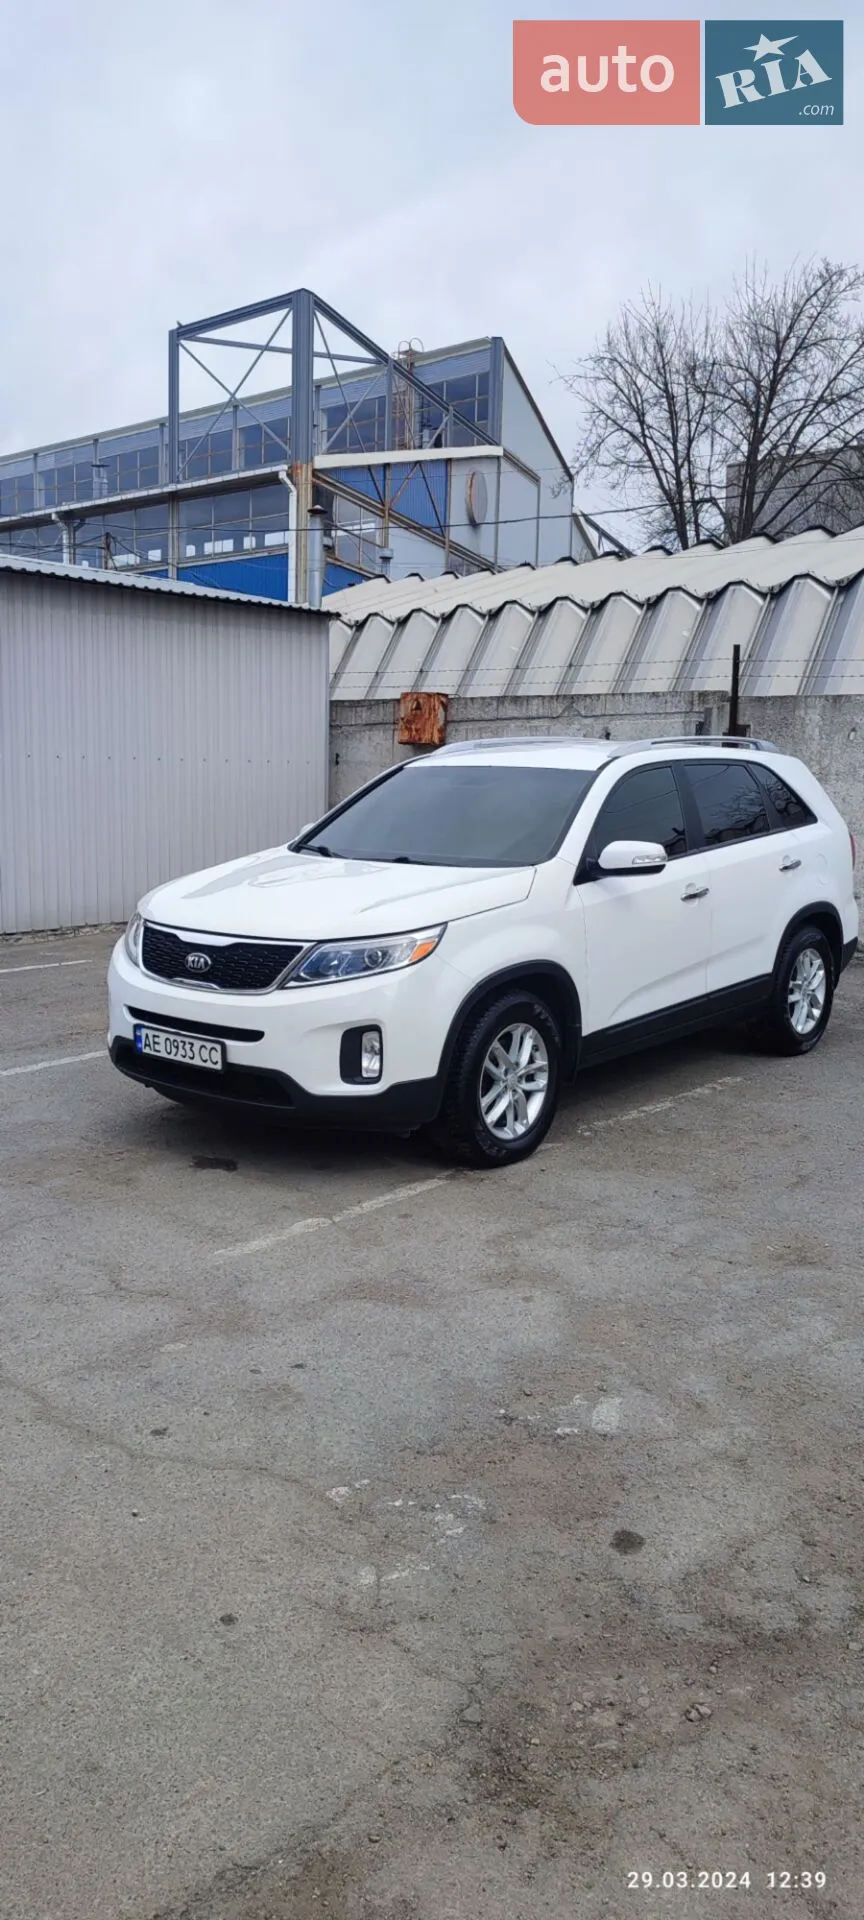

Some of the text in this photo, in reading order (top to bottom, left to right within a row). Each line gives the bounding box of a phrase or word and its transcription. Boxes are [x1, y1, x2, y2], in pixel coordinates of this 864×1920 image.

[188, 956, 205, 969] KIA
[144, 1033, 219, 1065] AE 0933 CC
